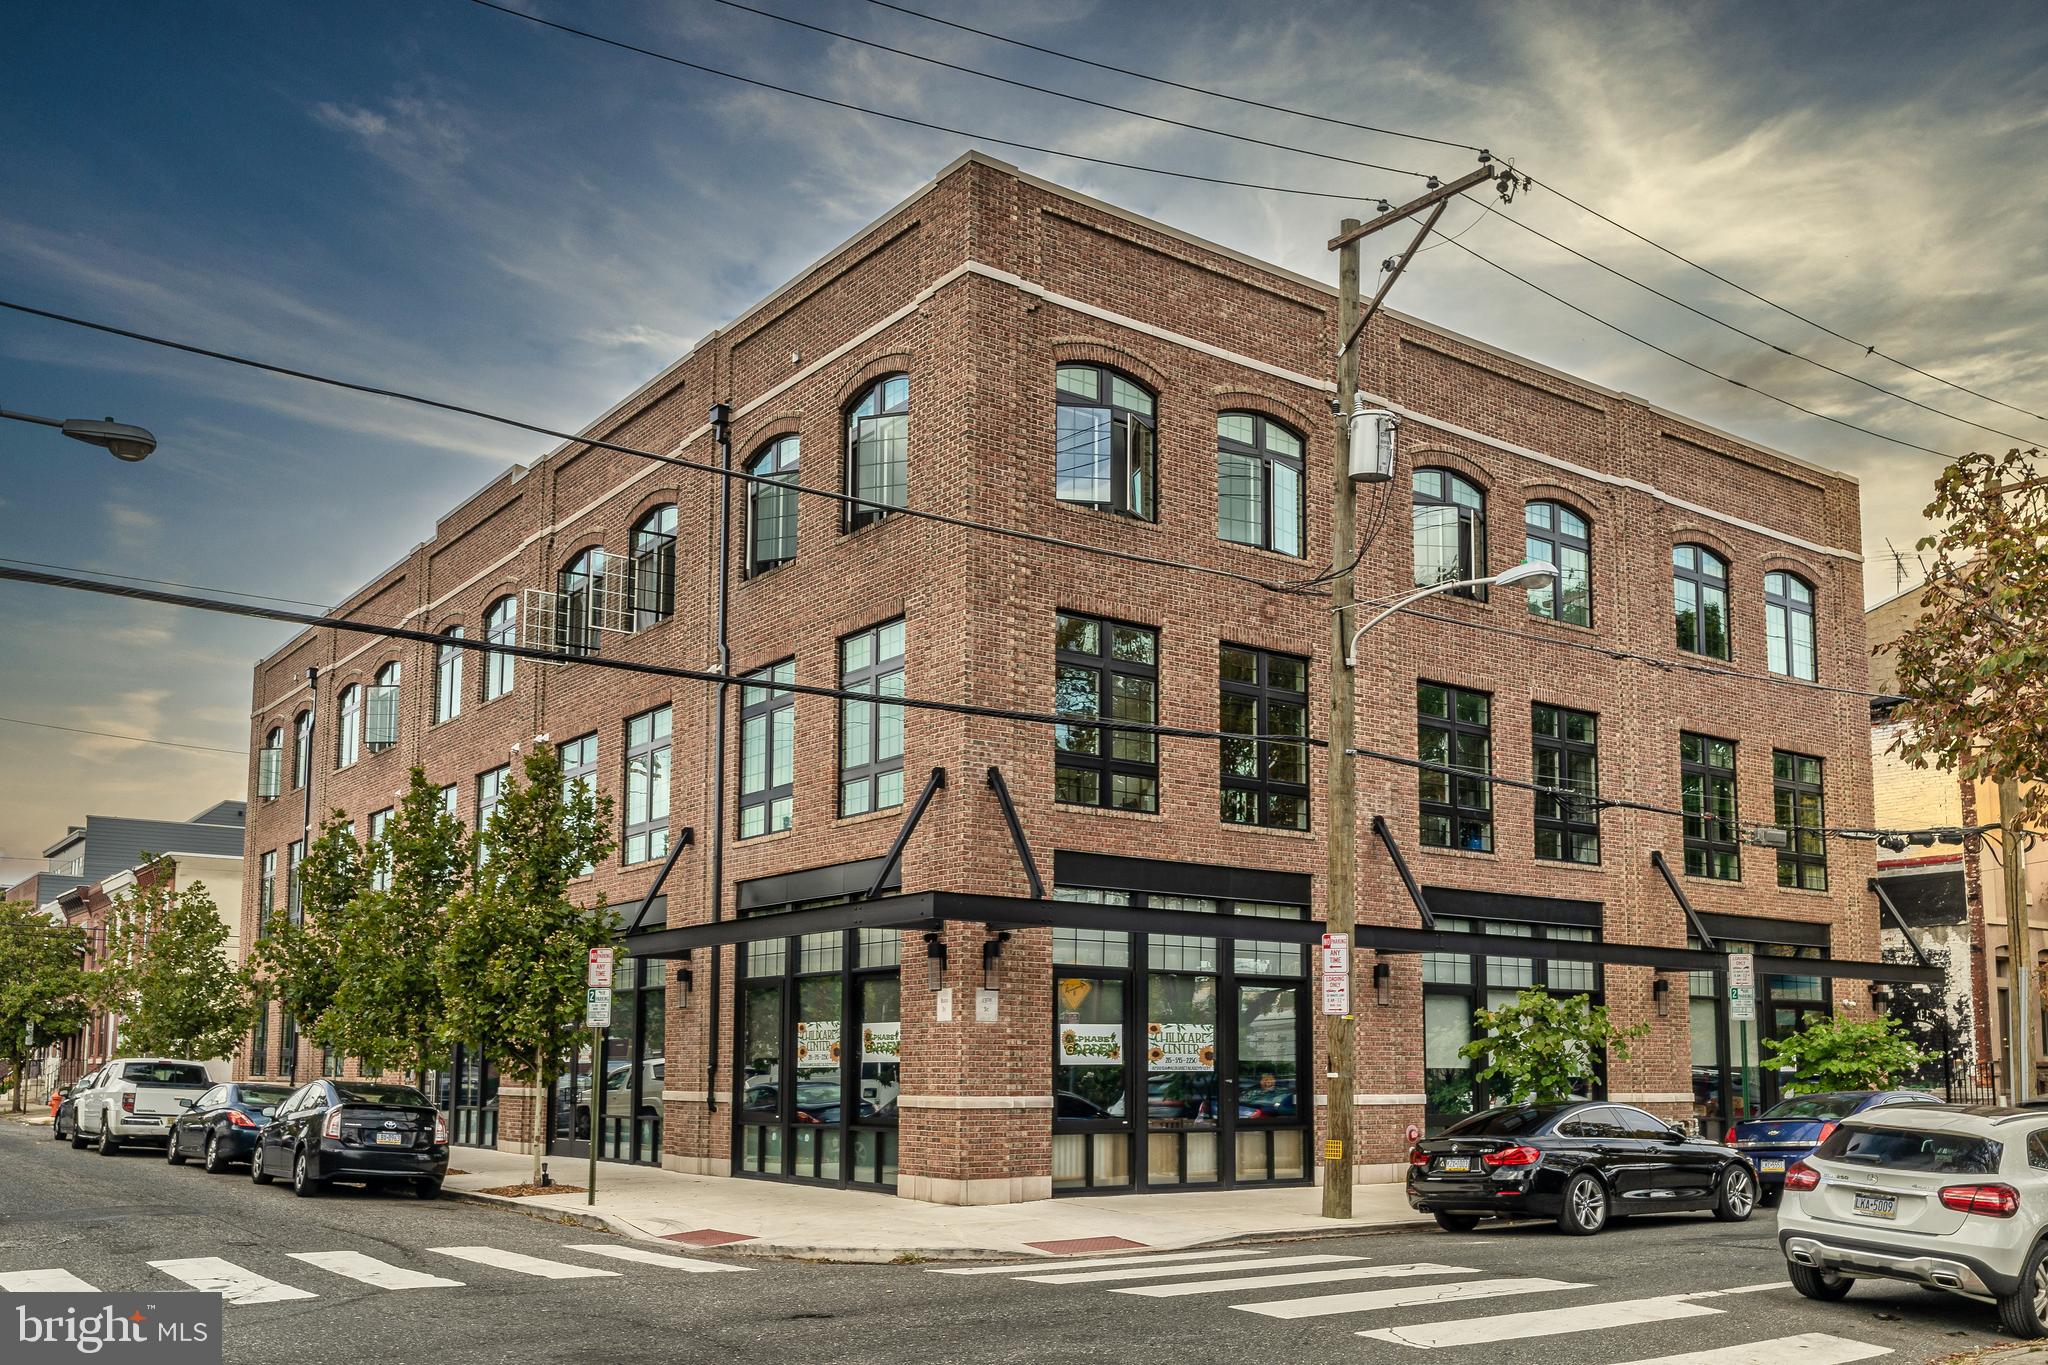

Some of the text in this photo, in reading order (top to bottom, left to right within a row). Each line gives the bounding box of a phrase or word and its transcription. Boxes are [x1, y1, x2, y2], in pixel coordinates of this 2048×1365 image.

[589, 991, 595, 1001] 2
[1732, 989, 1738, 999] 2
[1065, 1034, 1116, 1043] ALPHABET
[1155, 1032, 1208, 1043] CHILDCARE
[1065, 1043, 1118, 1056] GARDEN
[1163, 1043, 1200, 1054] CENTER
